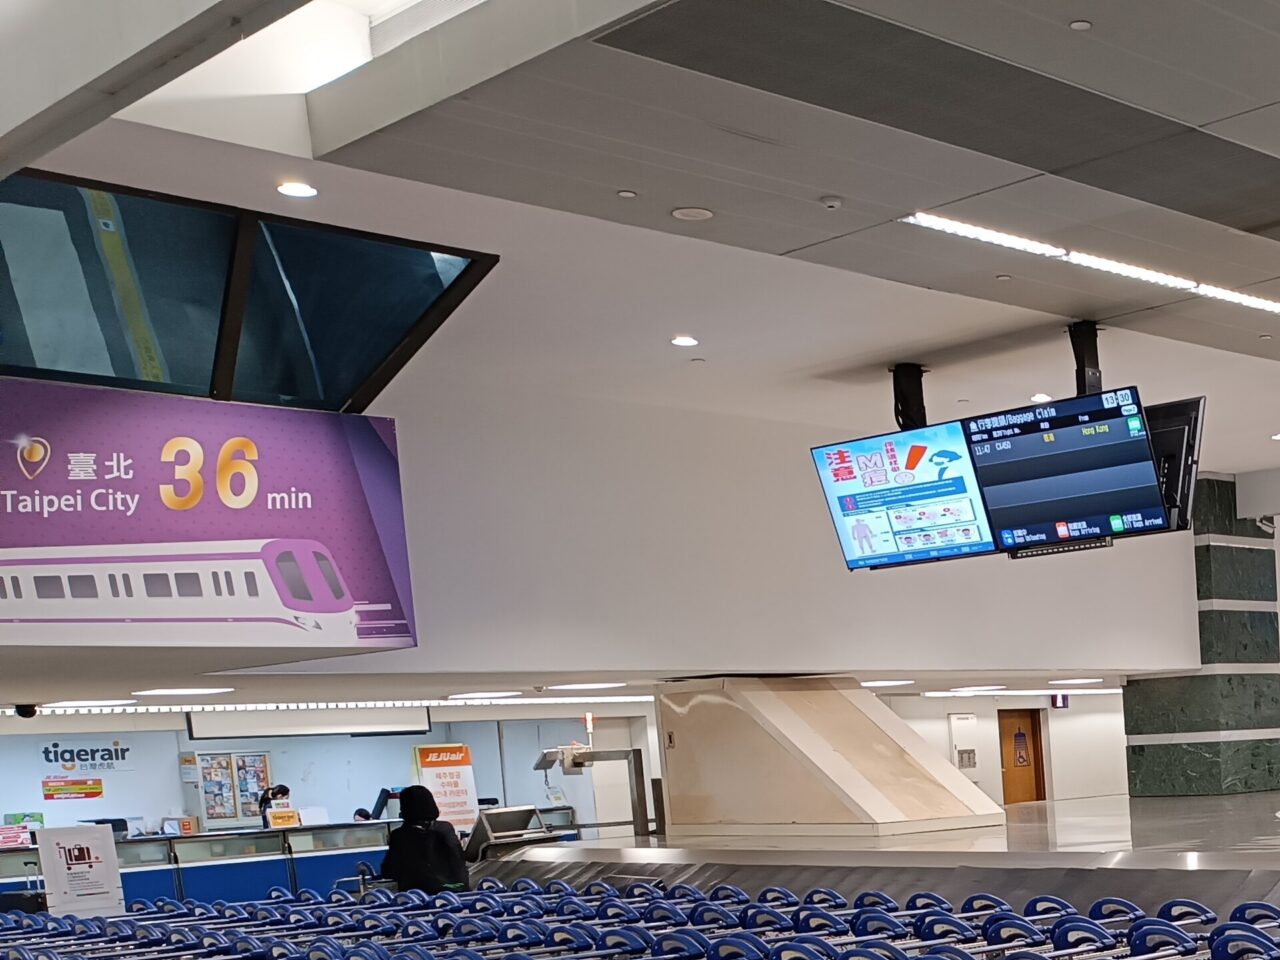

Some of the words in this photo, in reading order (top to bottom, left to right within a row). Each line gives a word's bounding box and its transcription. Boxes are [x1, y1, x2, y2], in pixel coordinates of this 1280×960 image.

[1103, 391, 1131, 407] 13:30
[1082, 426, 1095, 436] Hong
[1096, 424, 1109, 433] Kong
[67, 452, 134, 481] 臺北
[159, 436, 260, 511] 36
[267, 488, 313, 510] min
[825, 449, 857, 483] 注意
[1, 489, 82, 518] Taipei
[90, 488, 140, 516] City
[42, 741, 130, 771] tigerair
[425, 752, 465, 762] JEJUair
